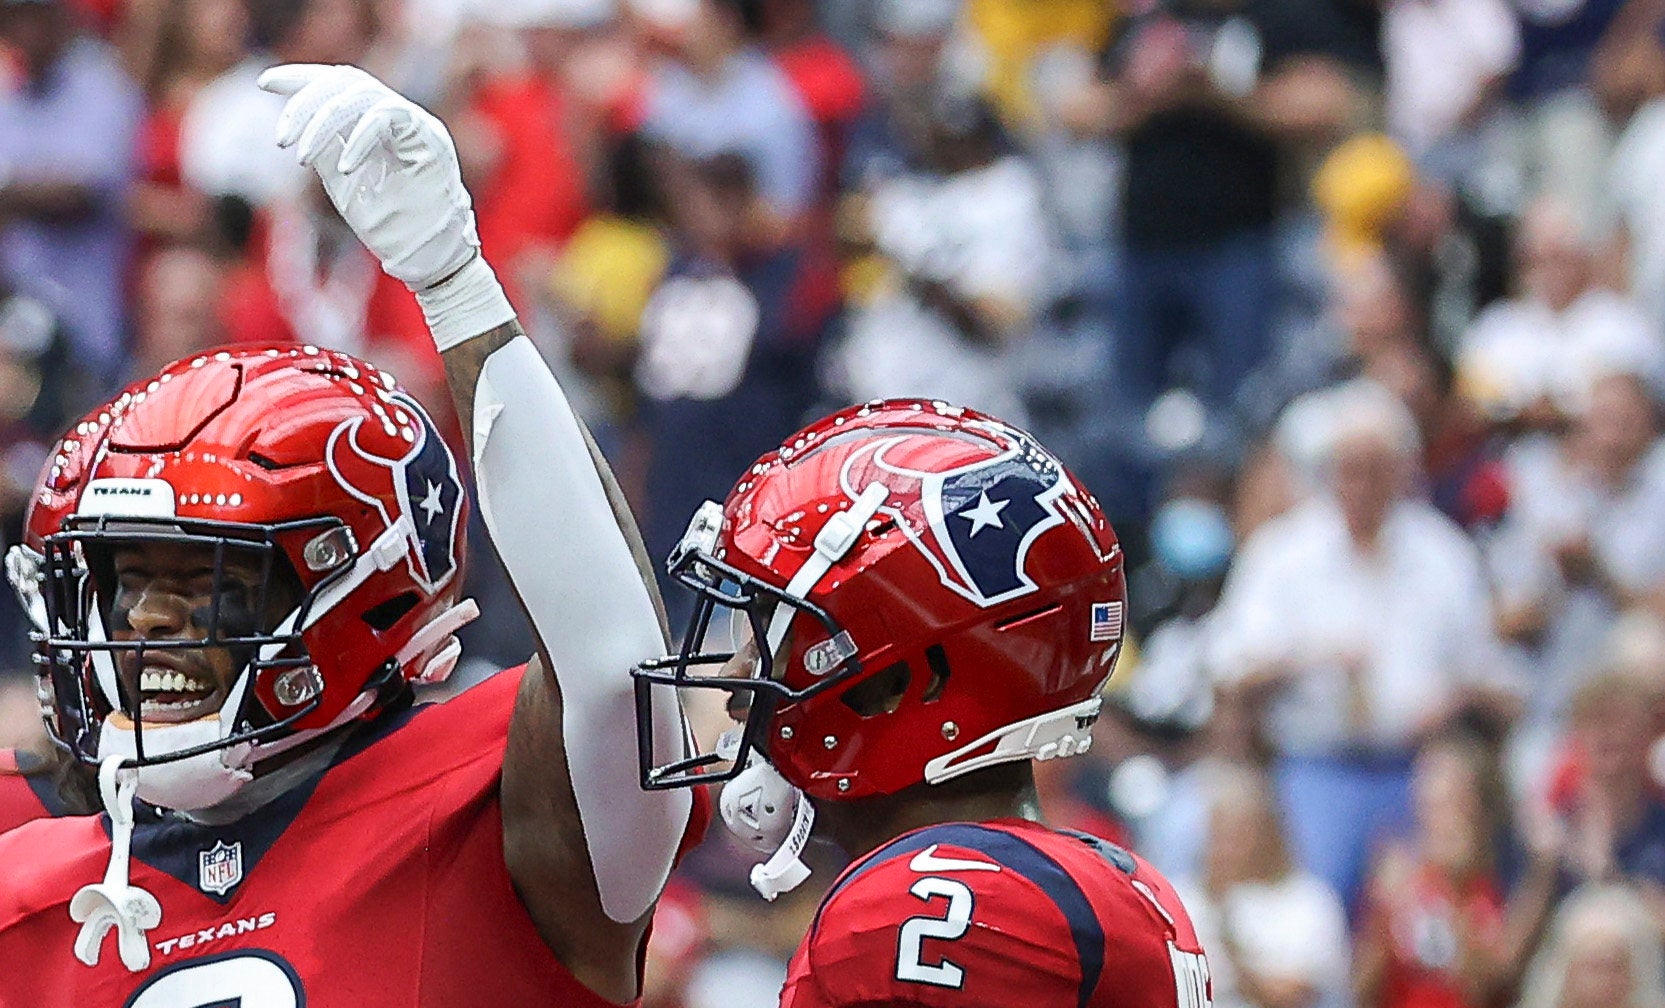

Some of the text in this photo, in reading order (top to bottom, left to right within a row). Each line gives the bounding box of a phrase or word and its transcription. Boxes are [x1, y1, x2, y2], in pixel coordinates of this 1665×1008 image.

[93, 486, 153, 496] TEXANS
[207, 860, 235, 884] NFL
[154, 911, 277, 956] TEXANS
[895, 875, 974, 990] 2
